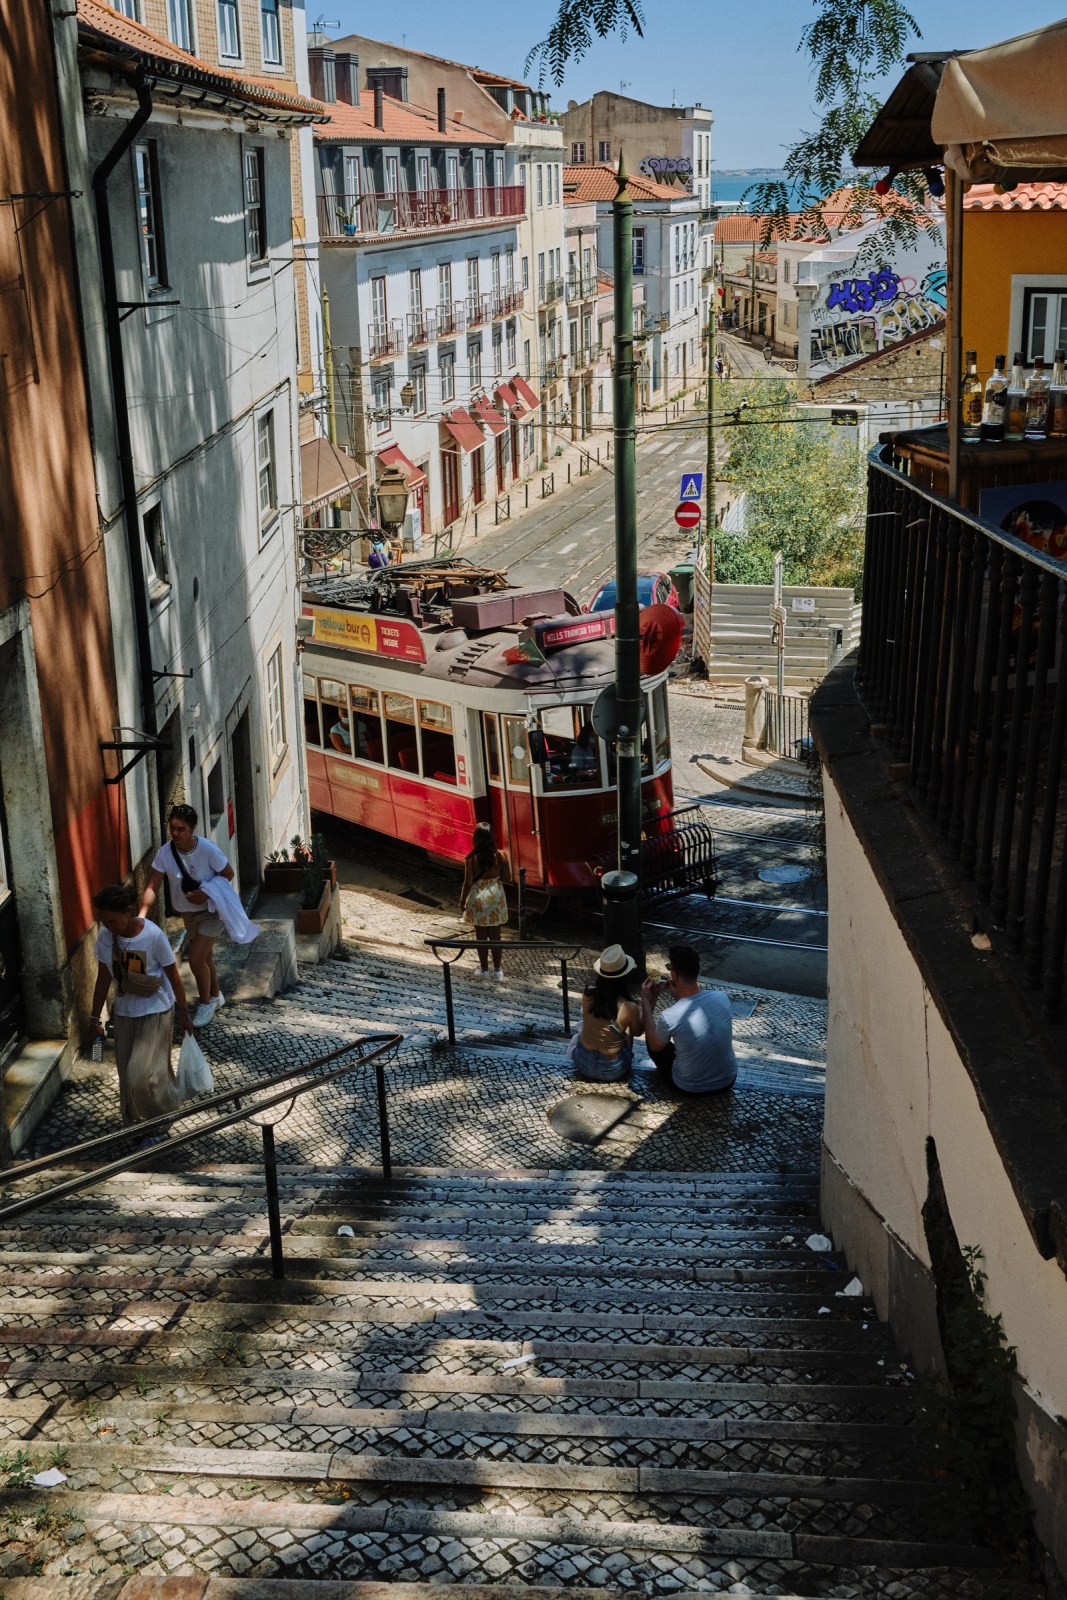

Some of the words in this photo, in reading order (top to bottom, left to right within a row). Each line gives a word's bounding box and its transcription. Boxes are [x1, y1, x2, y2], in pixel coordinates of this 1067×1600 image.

[346, 619, 360, 634] bus
[381, 627, 399, 637] TICKETS
[383, 639, 399, 648] INSIDE
[602, 812, 618, 824] HILL
